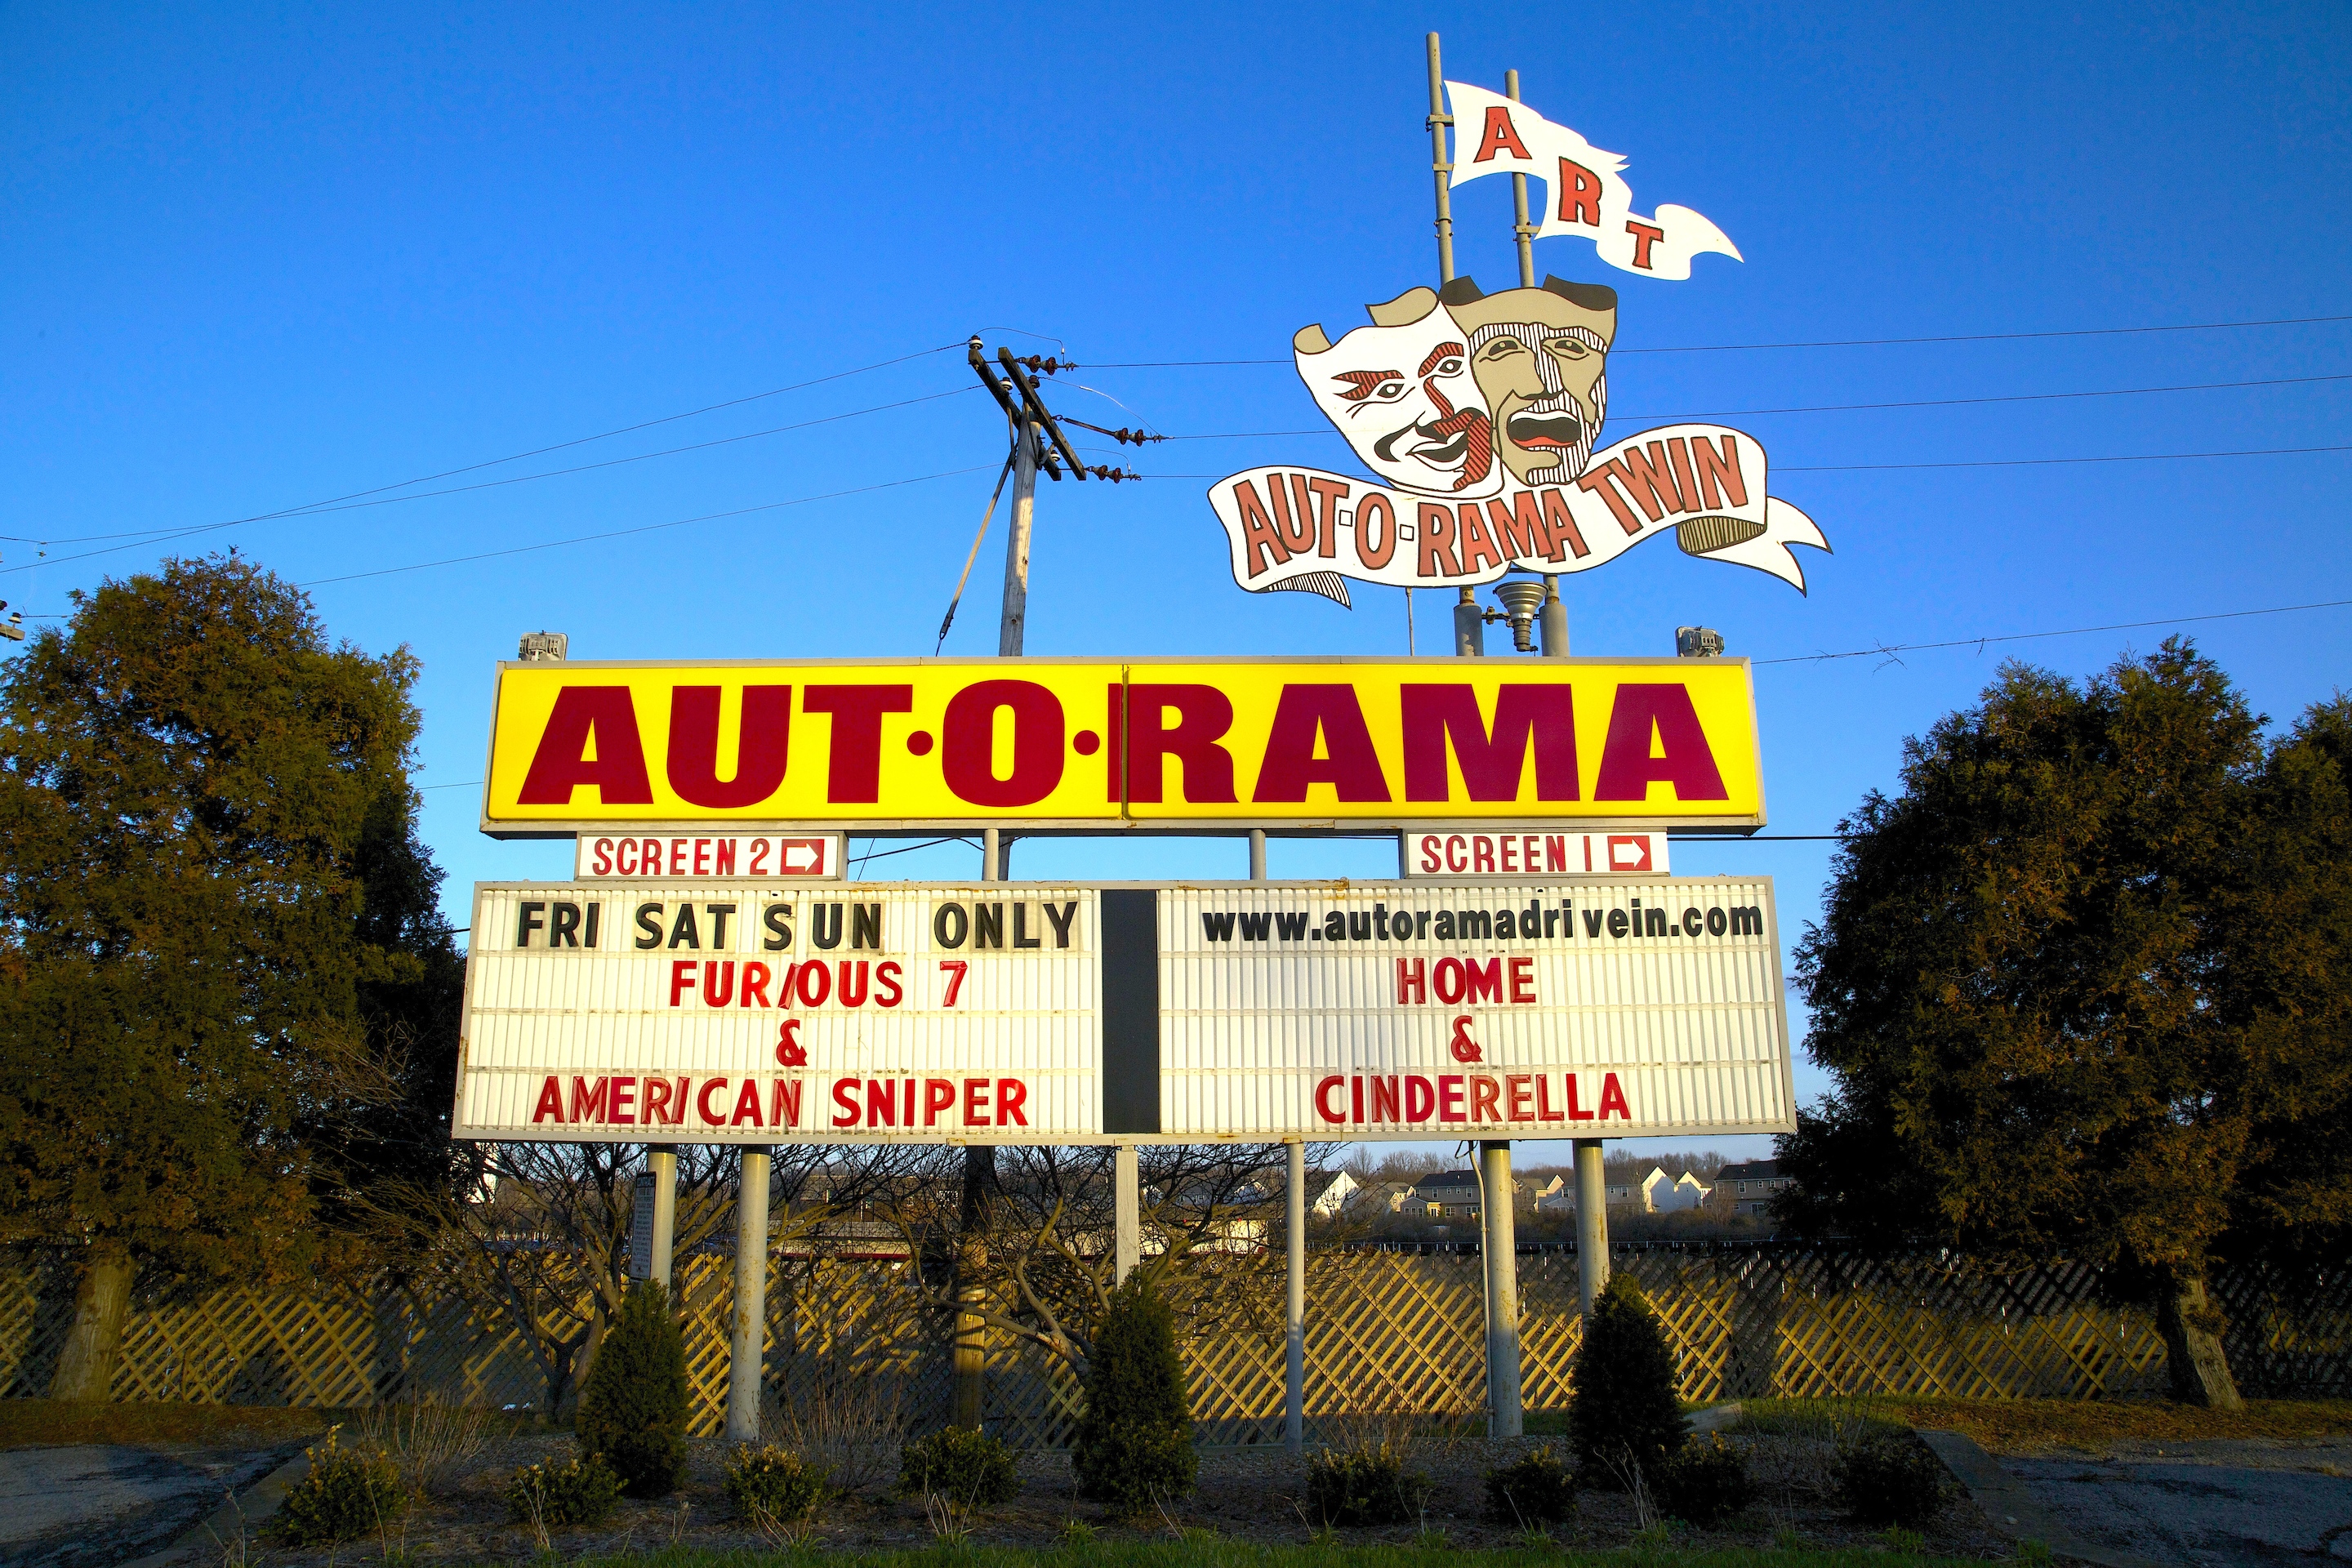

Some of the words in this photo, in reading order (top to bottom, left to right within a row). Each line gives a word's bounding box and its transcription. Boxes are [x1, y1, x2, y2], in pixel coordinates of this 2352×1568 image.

[1473, 105, 1664, 270] ART
[1577, 434, 1748, 538] TWIN
[592, 837, 737, 875] SCREEN
[749, 837, 770, 875] 2
[1421, 835, 1566, 873] SCREEN
[517, 902, 600, 948] FRI
[635, 902, 737, 950] SAT
[933, 901, 1078, 950] ONLY
[1202, 898, 1763, 942] www.autoramadrivein.com
[670, 960, 903, 1009] FURIOUS
[939, 960, 969, 1008] 7
[1396, 956, 1537, 1005] HOME
[775, 1018, 808, 1067] &
[1450, 1014, 1483, 1063] &
[532, 1076, 802, 1128] AMERICAN
[832, 1077, 1029, 1128] SNIPER
[1315, 1072, 1632, 1125] CINDERELLA
